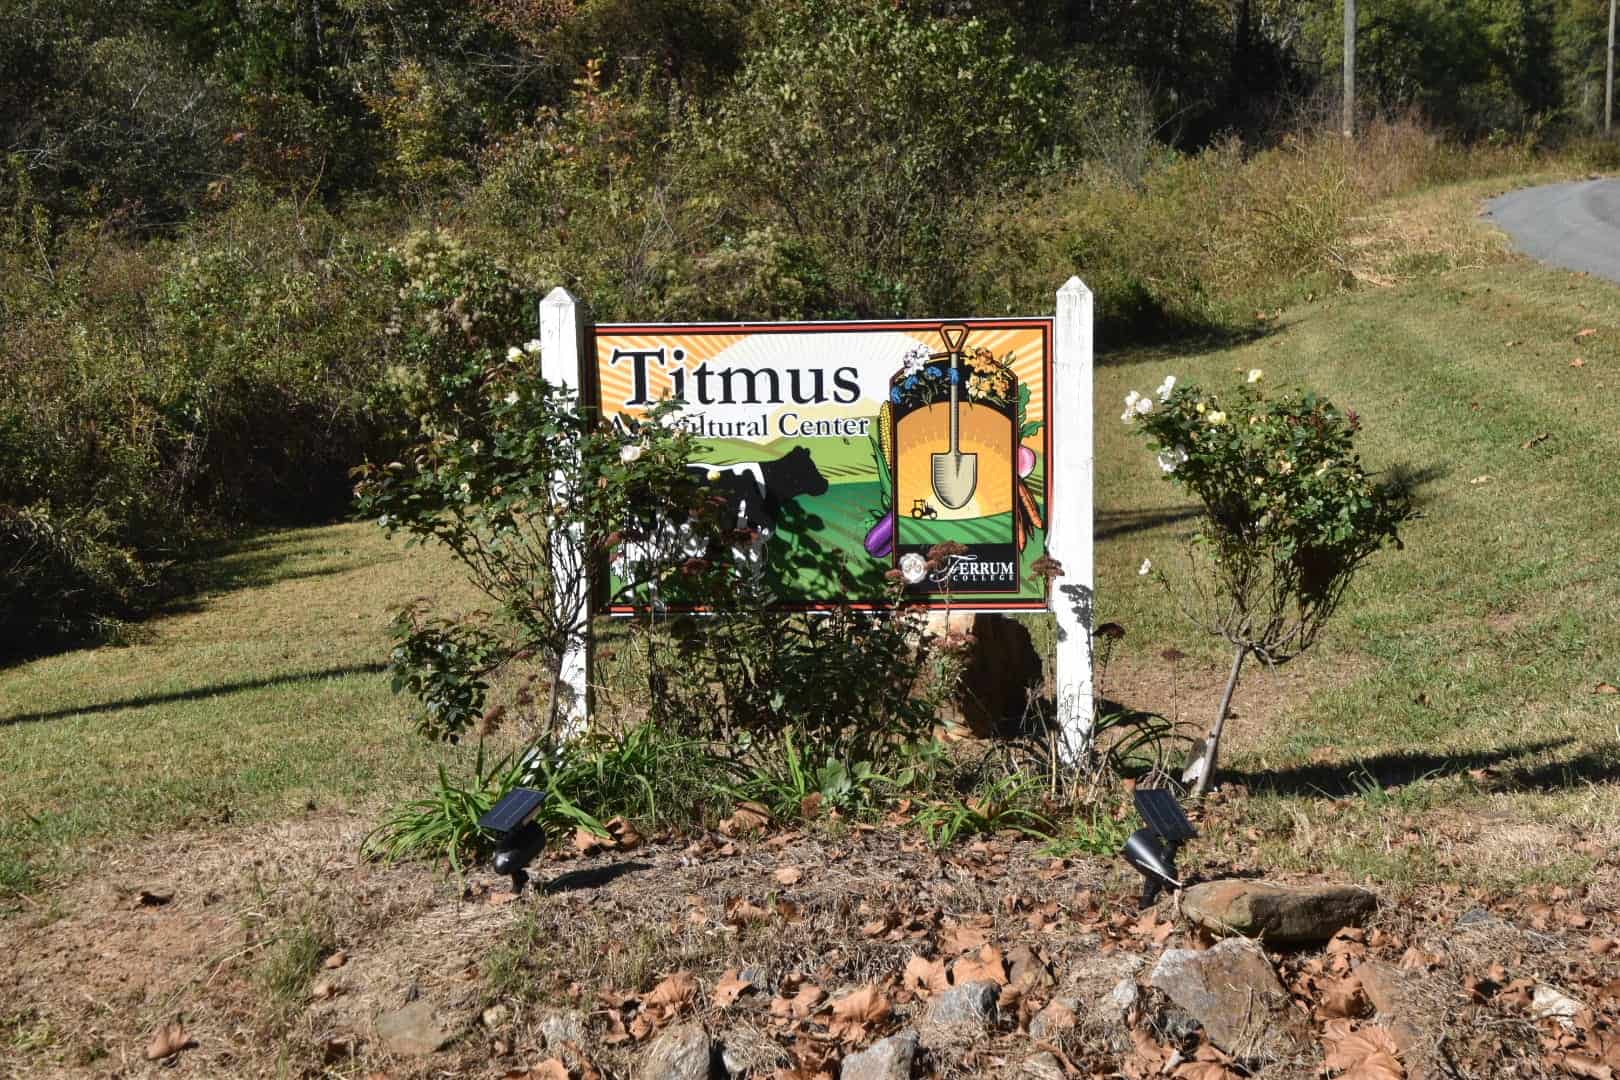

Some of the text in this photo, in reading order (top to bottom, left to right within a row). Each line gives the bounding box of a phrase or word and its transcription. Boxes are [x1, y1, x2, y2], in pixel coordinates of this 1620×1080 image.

[612, 347, 861, 405] Titmus
[778, 413, 869, 437] Center
[952, 574, 1014, 582] COLLEGE
